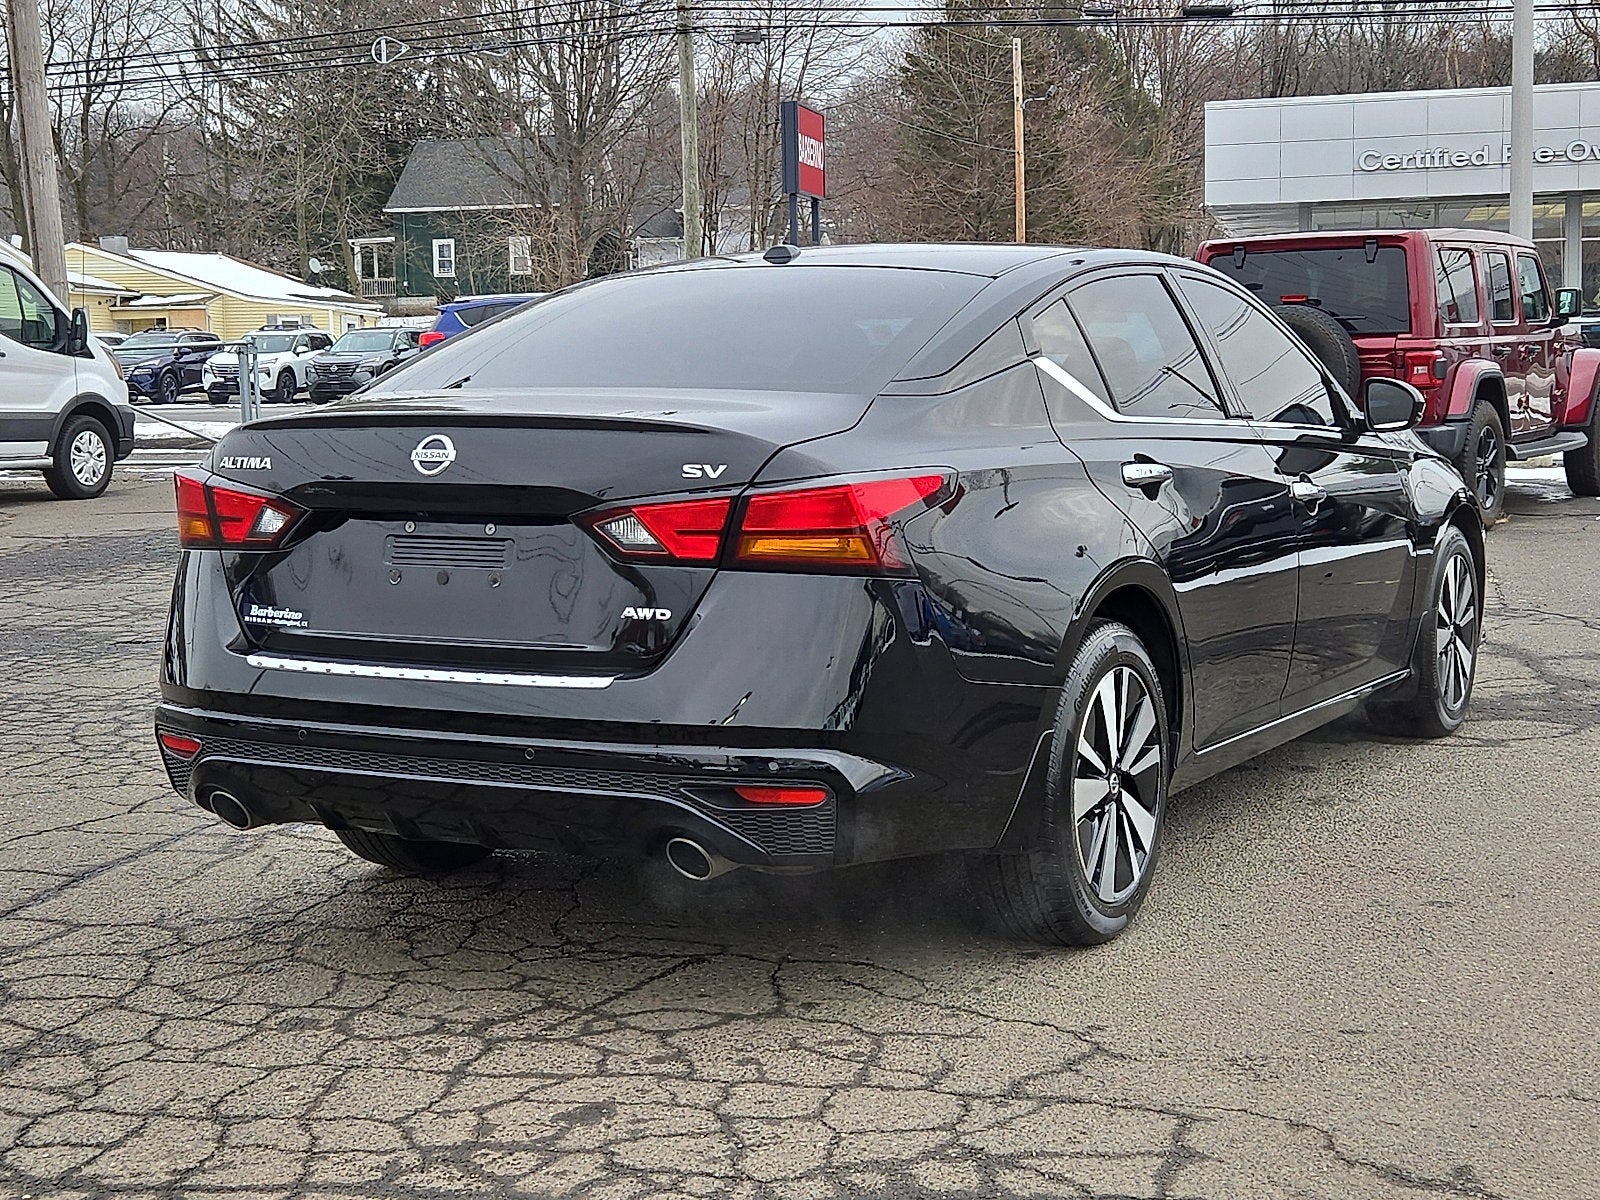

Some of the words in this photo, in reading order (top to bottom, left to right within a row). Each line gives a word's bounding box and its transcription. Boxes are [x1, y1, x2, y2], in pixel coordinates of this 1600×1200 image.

[1358, 145, 1490, 171] Certified
[414, 451, 450, 459] NISSAN
[219, 456, 272, 470] ALTIMA
[681, 464, 728, 479] SV
[249, 604, 303, 620] Barberino
[620, 606, 672, 620] AWD
